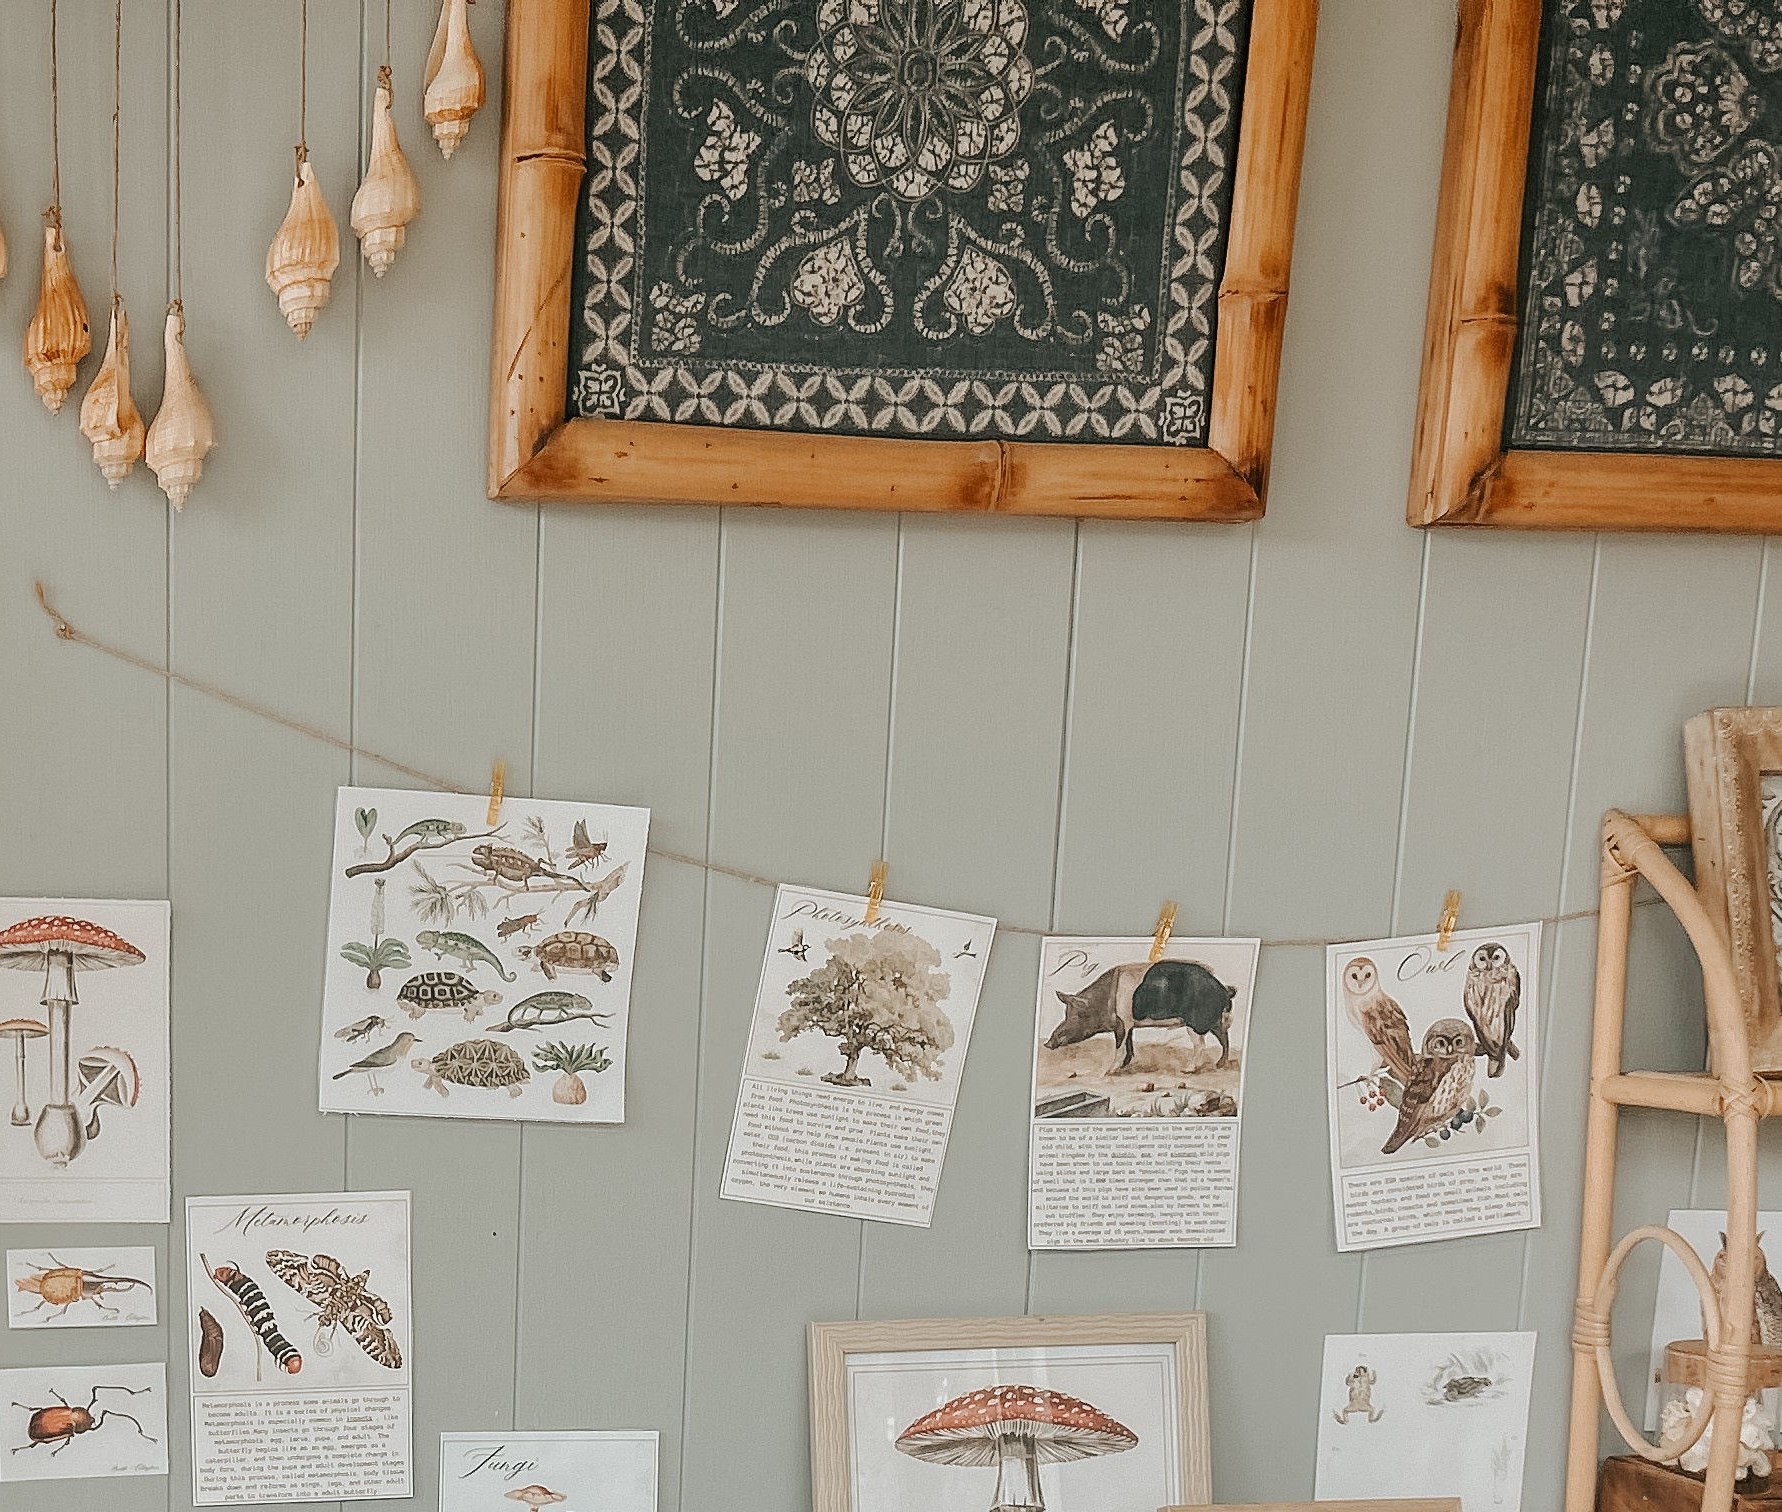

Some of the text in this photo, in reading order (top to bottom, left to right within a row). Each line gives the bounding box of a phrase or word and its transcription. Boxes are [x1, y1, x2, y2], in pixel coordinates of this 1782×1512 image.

[1048, 949, 1100, 978] Pig
[1397, 945, 1466, 982] Owl
[213, 1206, 370, 1237] Metamorphosis
[458, 1445, 540, 1481] Fungi
